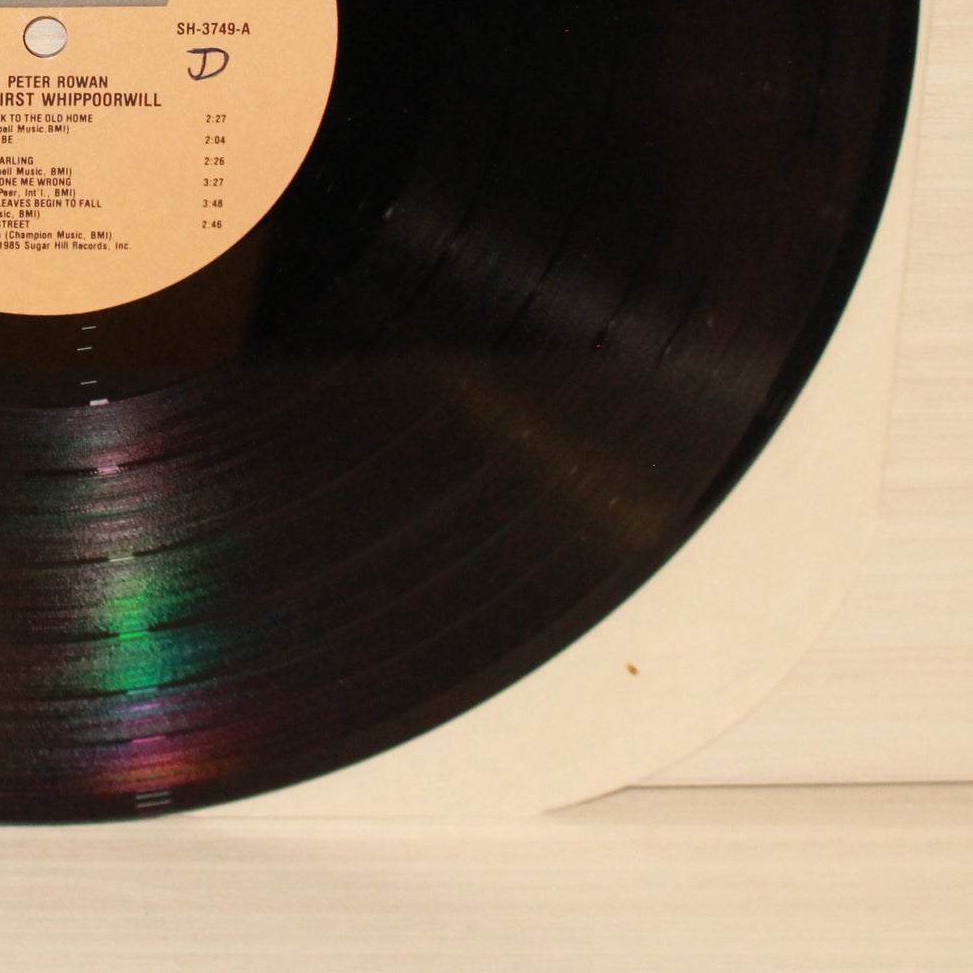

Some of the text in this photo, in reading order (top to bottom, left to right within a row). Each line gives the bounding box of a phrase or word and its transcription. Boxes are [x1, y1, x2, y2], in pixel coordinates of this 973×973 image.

[177, 22, 250, 35] SH-3749-A
[8, 75, 108, 88] PETER ROWAN
[42, 92, 162, 107] WHIPPOORWILL
[10, 114, 21, 122] TO
[24, 114, 42, 122] THE
[45, 114, 63, 123] OLD
[66, 114, 93, 123] HOME
[206, 114, 226, 123] 2:27
[2, 135, 13, 144] BE
[205, 135, 225, 144] 2:04
[204, 157, 225, 165] 2:26
[51, 167, 72, 178] BMI)
[21, 178, 34, 186] ME
[37, 177, 71, 186] WRONG
[204, 178, 224, 187] 3:27
[55, 188, 75, 199] BMI)
[34, 199, 62, 207] BEGIN
[65, 199, 76, 208] TO
[79, 199, 101, 208] FALL
[203, 199, 223, 208] 3:48
[19, 210, 40, 219] BMI)
[202, 220, 222, 229] 2:46
[4, 231, 52, 241] (Champion
[91, 231, 112, 241] BMI)
[24, 241, 50, 251] Sugar
[55, 241, 68, 249] Hill
[115, 241, 131, 250] Inc.
